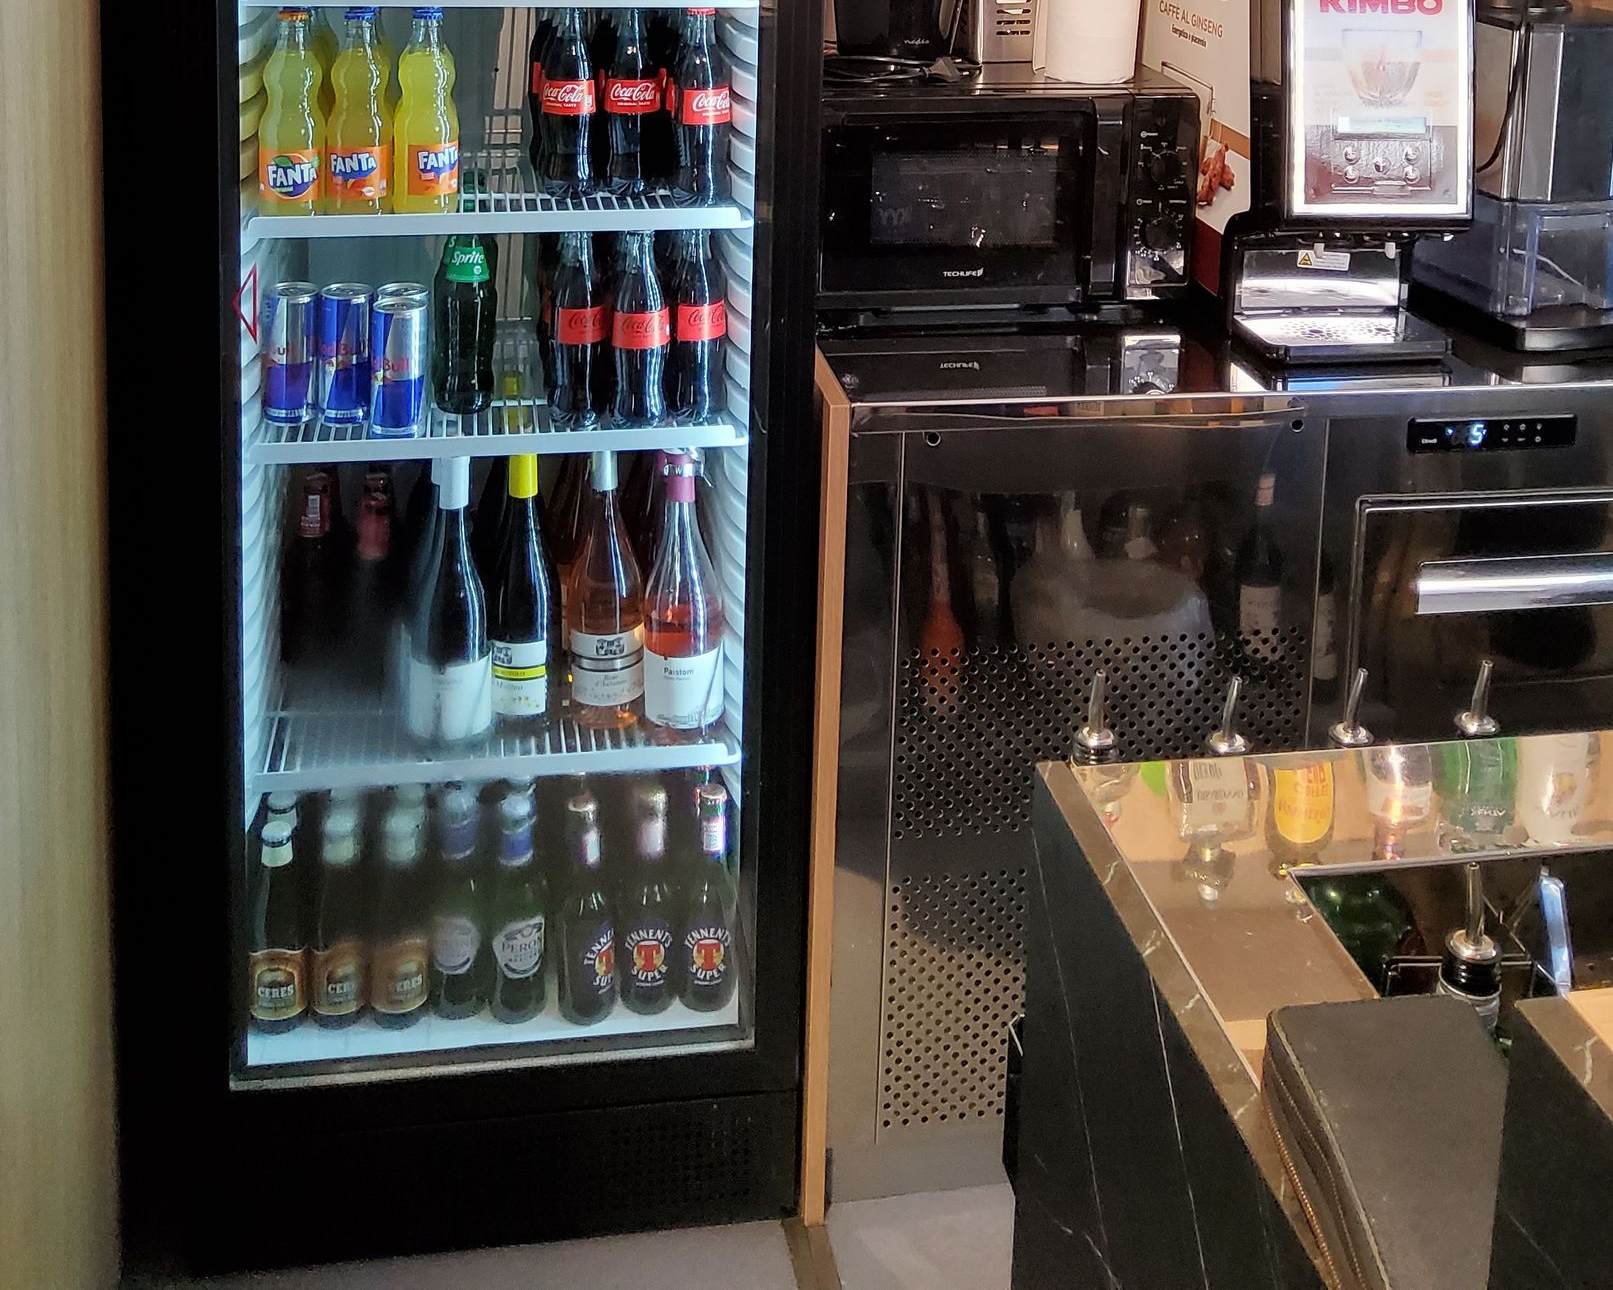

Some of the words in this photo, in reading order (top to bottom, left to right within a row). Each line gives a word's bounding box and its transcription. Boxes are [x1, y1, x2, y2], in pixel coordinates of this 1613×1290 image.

[1159, 0, 1181, 20] CAFFÈ
[1181, 10, 1191, 24] AL
[1190, 13, 1223, 39] GINSENG
[543, 83, 585, 103] Coca-Cola
[610, 82, 655, 102] Coca-Cola
[330, 153, 377, 174] FANTA
[267, 164, 319, 187] FANTA
[451, 251, 485, 265] Sprite
[624, 928, 673, 950] TENNENT'S
[684, 927, 731, 948] TENNENT'S
[631, 964, 668, 981] SUPER
[689, 963, 727, 981] SUPER
[257, 984, 294, 999] CERES
